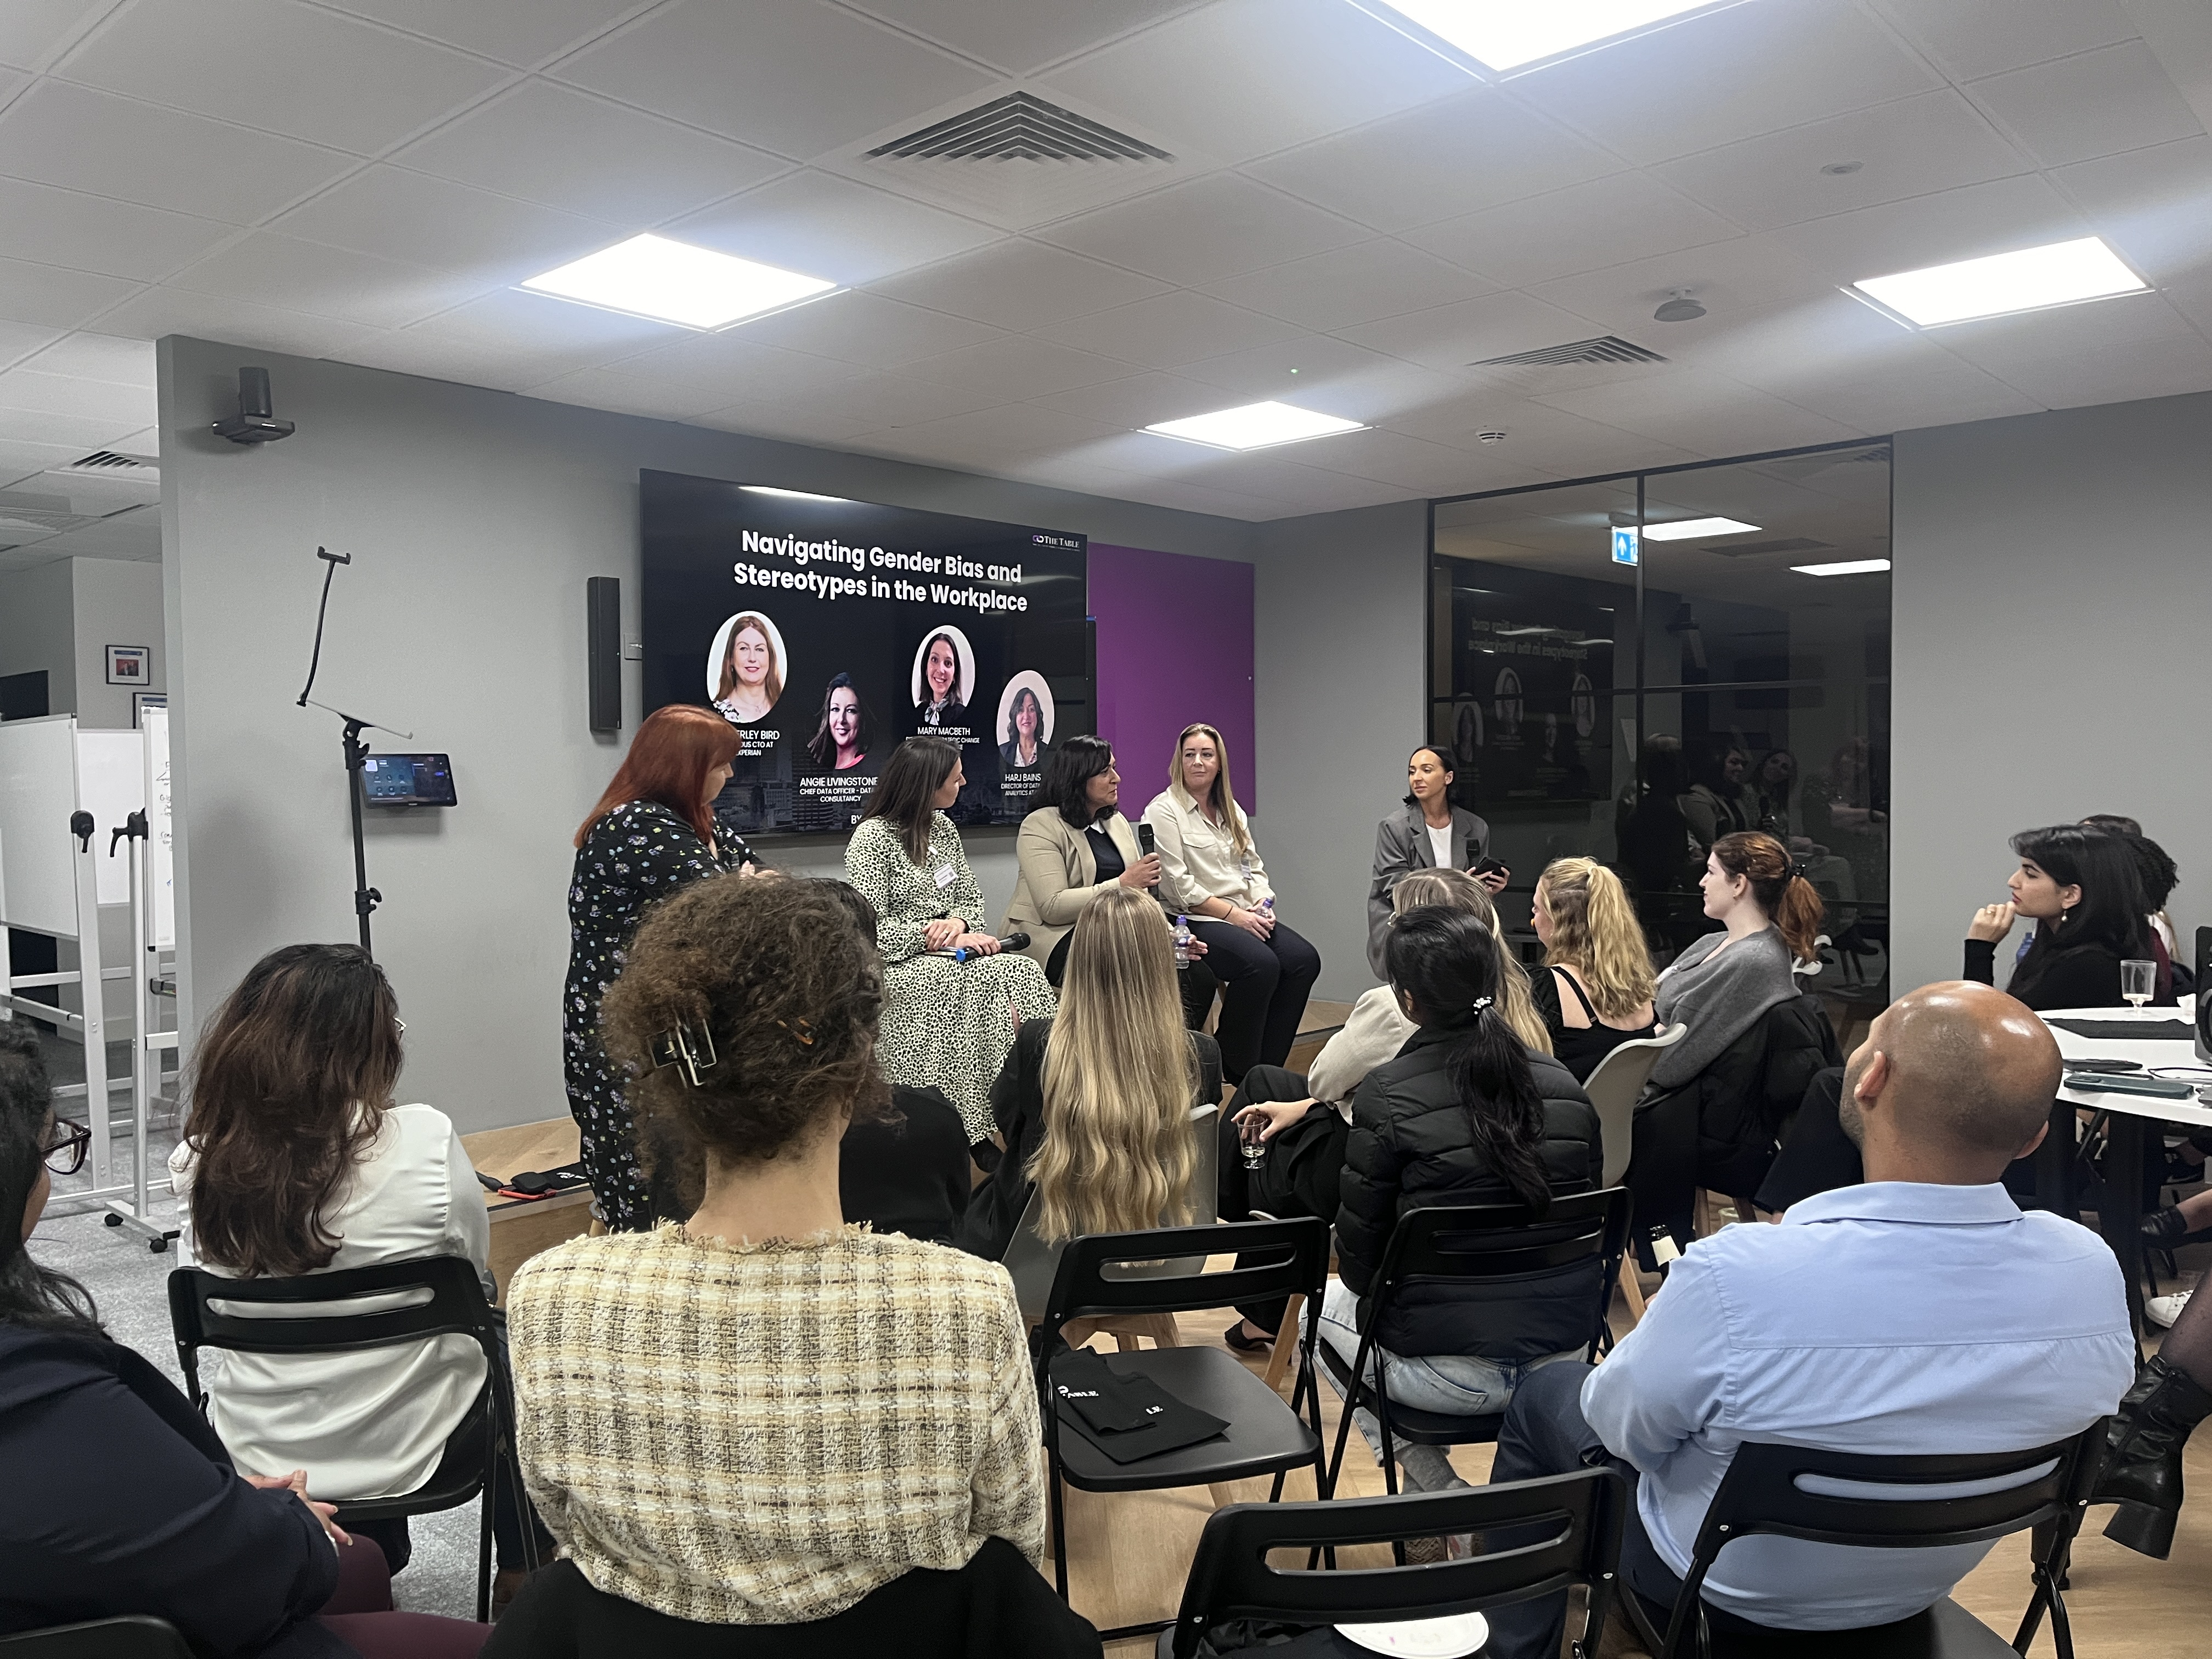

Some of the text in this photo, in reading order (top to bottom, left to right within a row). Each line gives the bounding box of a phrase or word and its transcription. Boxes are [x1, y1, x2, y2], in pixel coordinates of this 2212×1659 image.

[742, 530, 1022, 583] Navigating Gender Bias and
[734, 562, 1028, 614] Stereotypes in the Workplace
[737, 730, 780, 740] RLEY BIRD
[917, 726, 970, 736] MARY MACBETH
[799, 777, 878, 787] ANGIE LIVINGSTONE
[1005, 773, 1041, 782] HARJ BAINS
